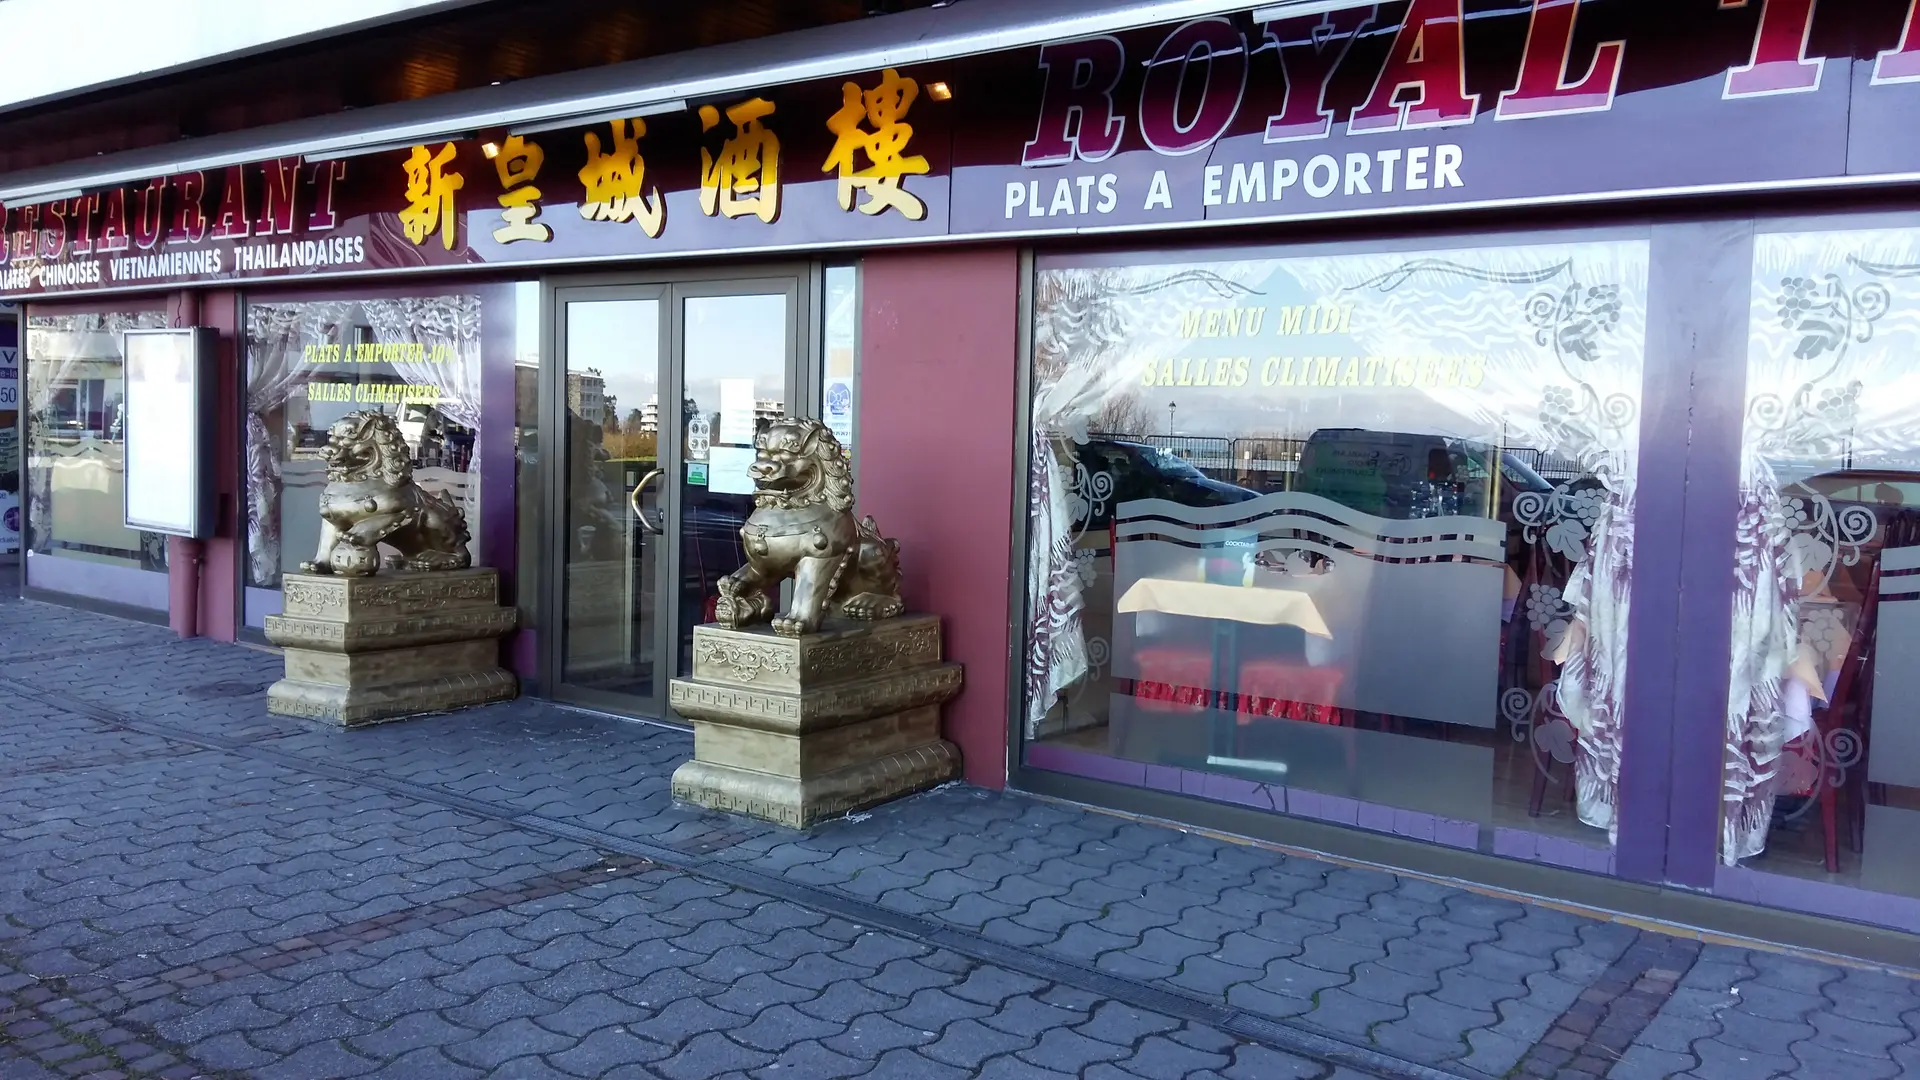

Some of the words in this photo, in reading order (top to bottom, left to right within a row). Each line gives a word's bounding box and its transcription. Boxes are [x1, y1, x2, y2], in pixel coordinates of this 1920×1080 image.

[1021, 0, 1627, 168] ROYAL
[398, 67, 931, 252] 新皇城酒樓
[1005, 170, 1118, 219] PLATS
[1144, 170, 1173, 211] A
[1203, 143, 1465, 207] EMPORTER
[39, 259, 100, 288] CHINOISES
[110, 248, 222, 281] VIETNAMIENNES
[234, 235, 365, 271] THAILANDAISES
[1179, 306, 1268, 340] MENU
[1276, 303, 1356, 336] MIDI
[304, 343, 341, 364] PLATS
[344, 344, 352, 363] A
[355, 343, 424, 363] EMPORTER
[1141, 356, 1252, 388] SALLES
[1260, 355, 1488, 389] CLIMATISEES
[308, 382, 352, 403] SALLES
[355, 383, 441, 405] CLIMATISEES
